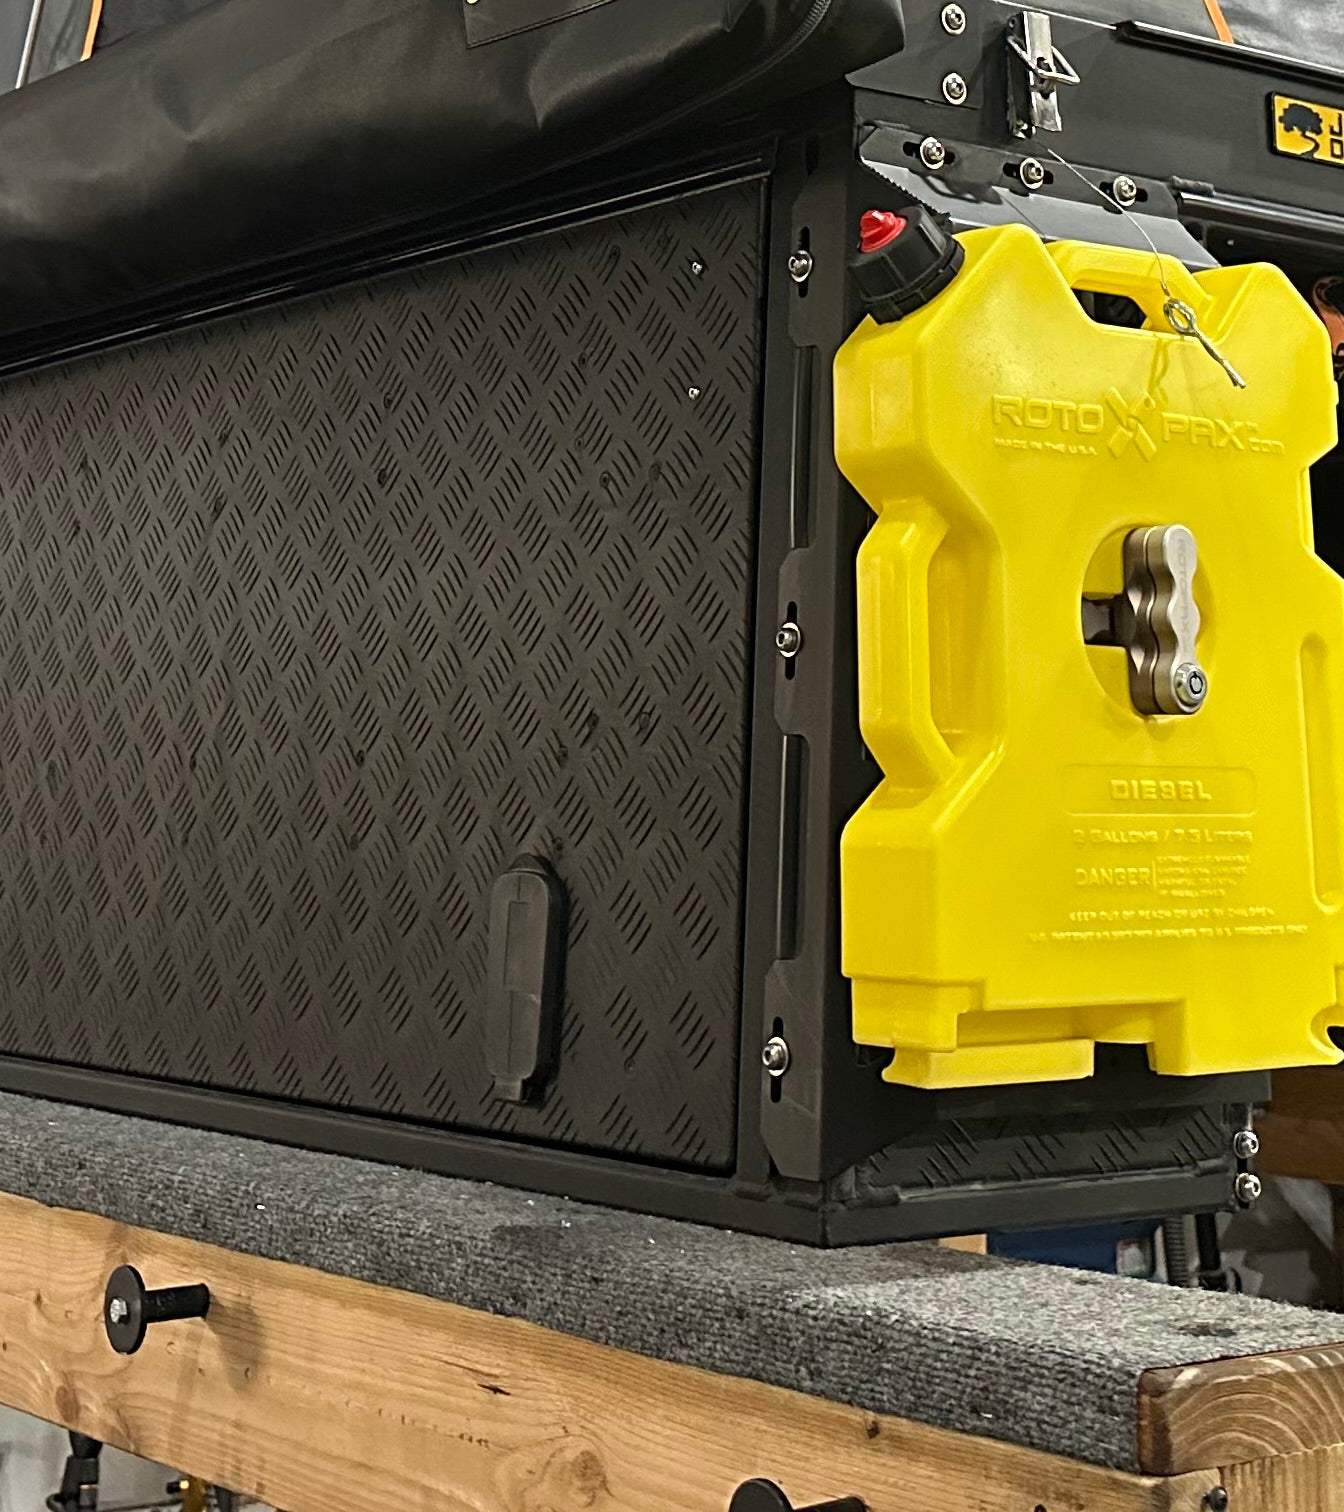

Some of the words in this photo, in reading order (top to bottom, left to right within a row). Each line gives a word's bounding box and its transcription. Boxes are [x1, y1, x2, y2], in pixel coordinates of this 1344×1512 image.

[991, 394, 1104, 434] ROTO
[1109, 779, 1213, 801] DIESEL
[1074, 867, 1152, 887] DANGER
